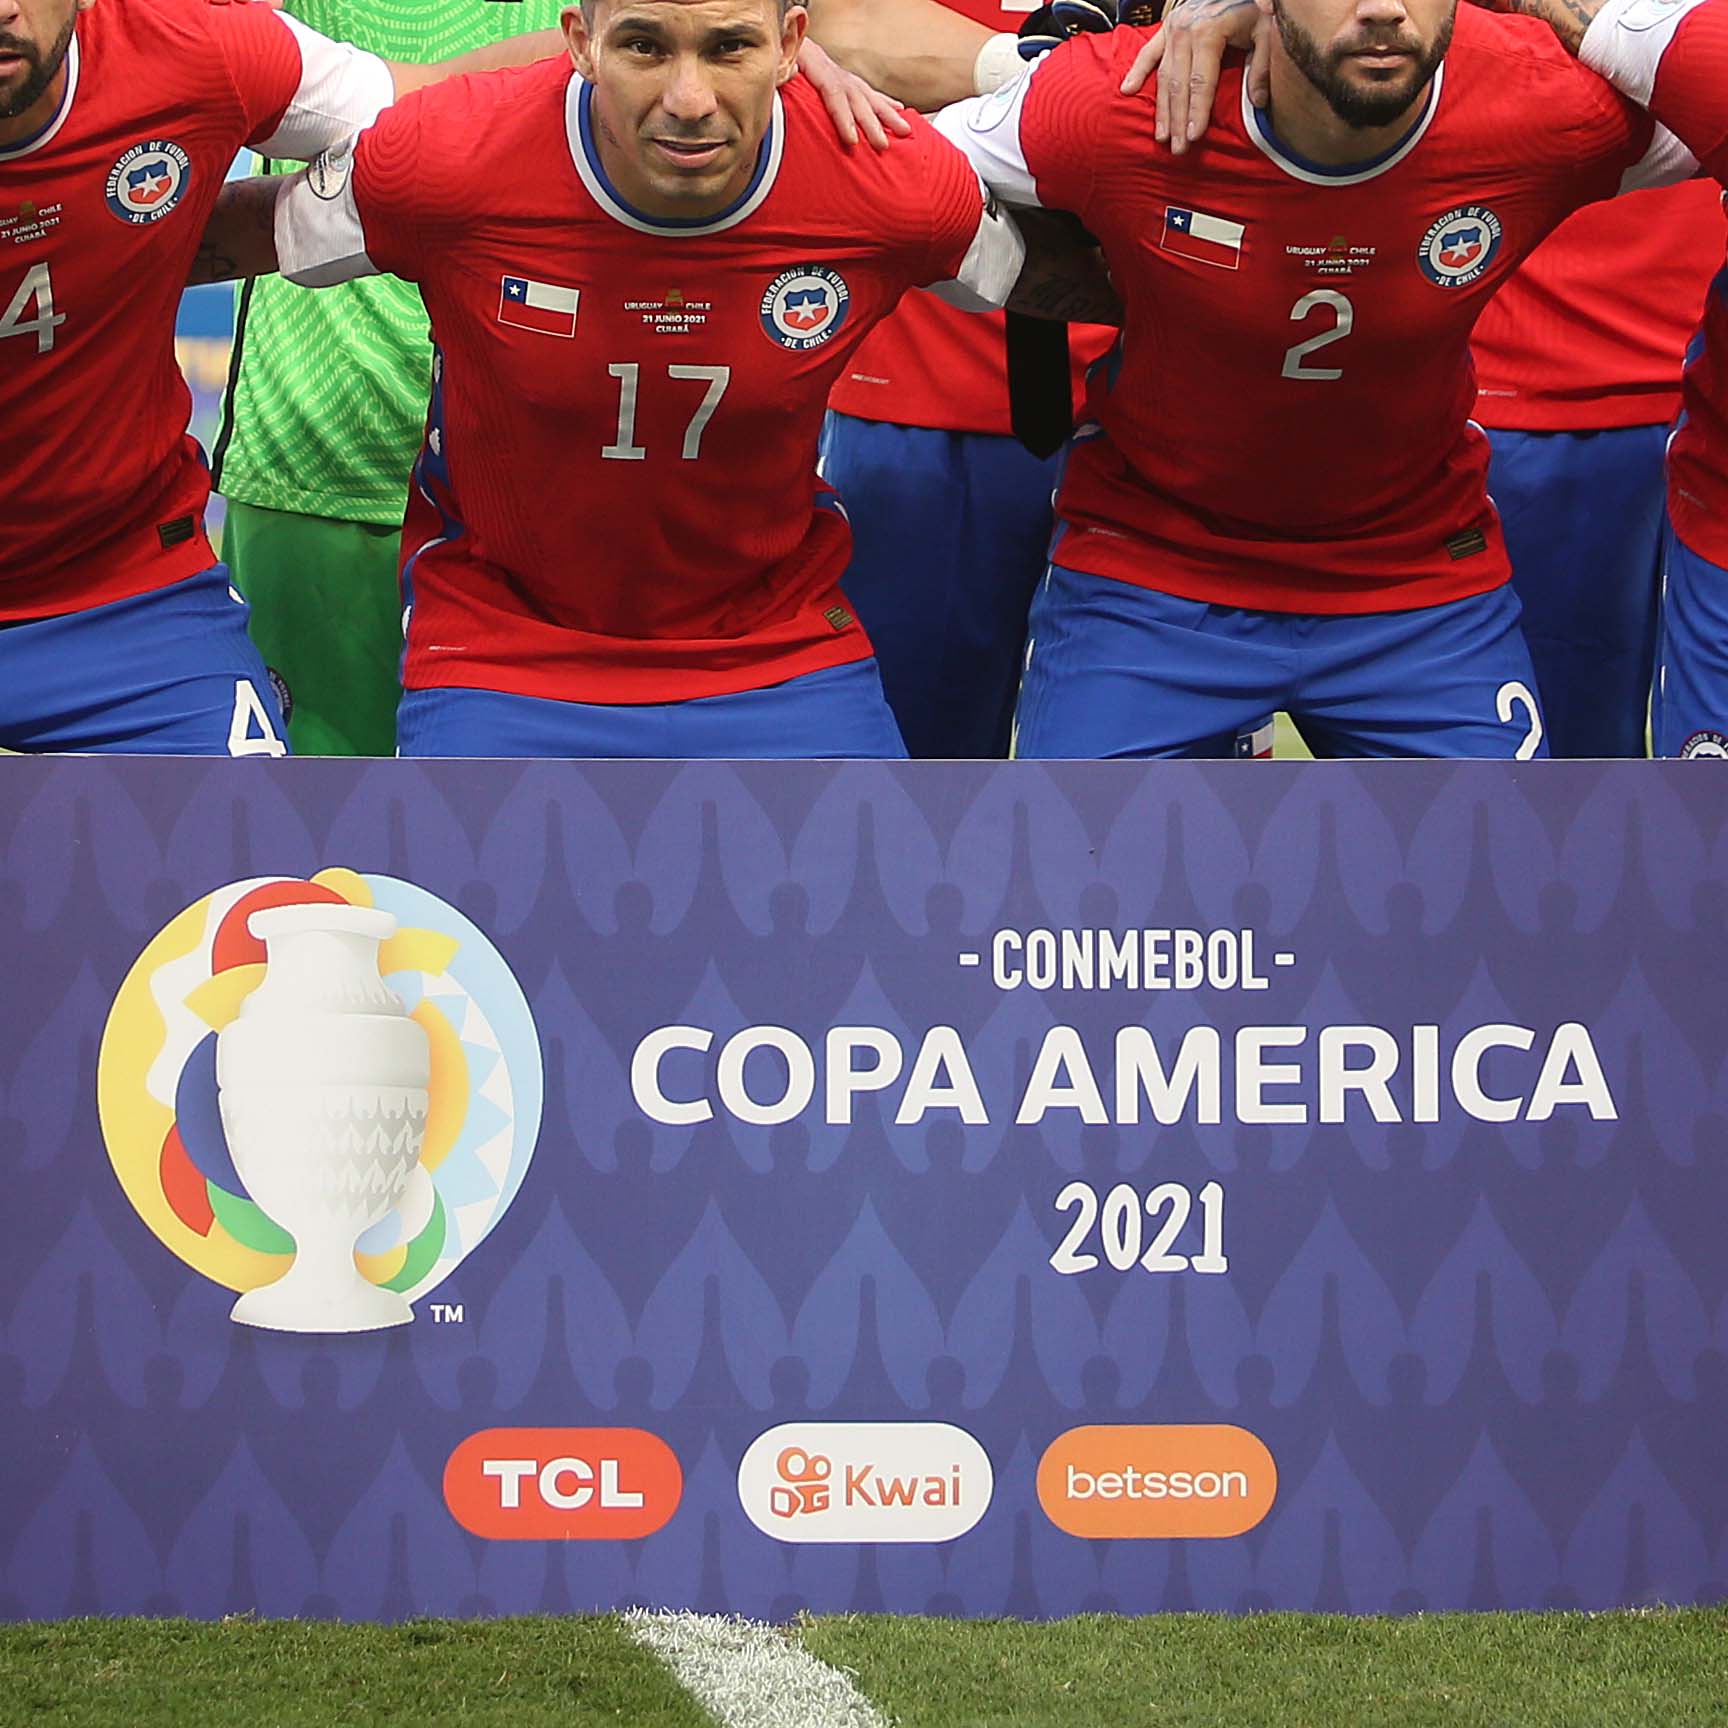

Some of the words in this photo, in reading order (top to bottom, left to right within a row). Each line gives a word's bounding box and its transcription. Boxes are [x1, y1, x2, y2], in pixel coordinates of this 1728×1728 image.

[106, 146, 143, 198] FEDERACION
[149, 141, 162, 152] DE
[38, 203, 62, 217] CHILE
[132, 213, 145, 223] DE
[762, 267, 805, 315] FEDERACION
[811, 266, 825, 277] DE
[826, 271, 849, 303] FUTBOL
[683, 315, 705, 323] 2021
[784, 338, 797, 349] DE
[803, 331, 828, 348] CHILE
[1281, 289, 1353, 380] 2
[601, 363, 730, 460] 17
[227, 680, 288, 758] 4
[1496, 681, 1544, 760] 2
[630, 1024, 989, 1126] COPA
[1015, 1021, 1618, 1126] AMERICA
[1050, 1180, 1228, 1275] 2021
[430, 1304, 464, 1322] TM
[482, 1458, 644, 1510] TCL
[844, 1464, 961, 1508] Kwai
[1066, 1464, 1248, 1500] betsson
